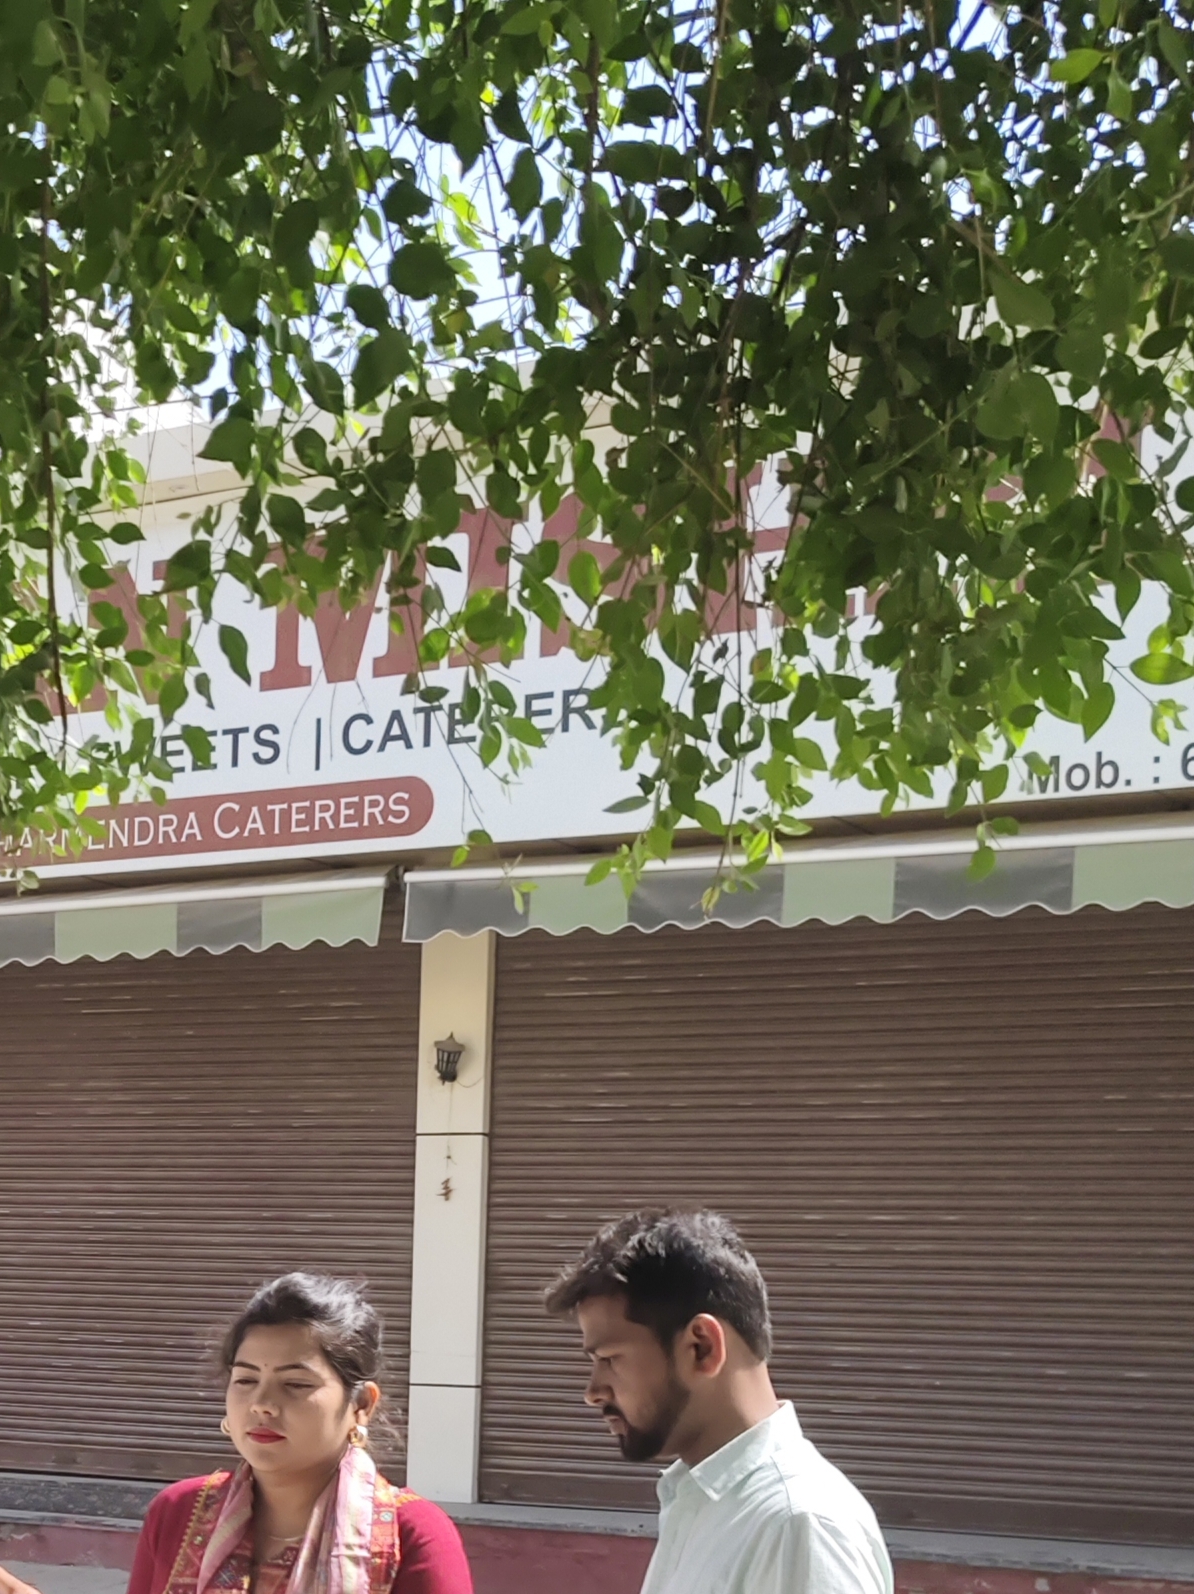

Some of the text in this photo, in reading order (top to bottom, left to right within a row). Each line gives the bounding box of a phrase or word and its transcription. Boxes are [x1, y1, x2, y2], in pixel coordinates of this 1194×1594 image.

[342, 688, 600, 756] CATEER
[1025, 751, 1131, 795] Mob.
[213, 792, 411, 840] CATERERS
